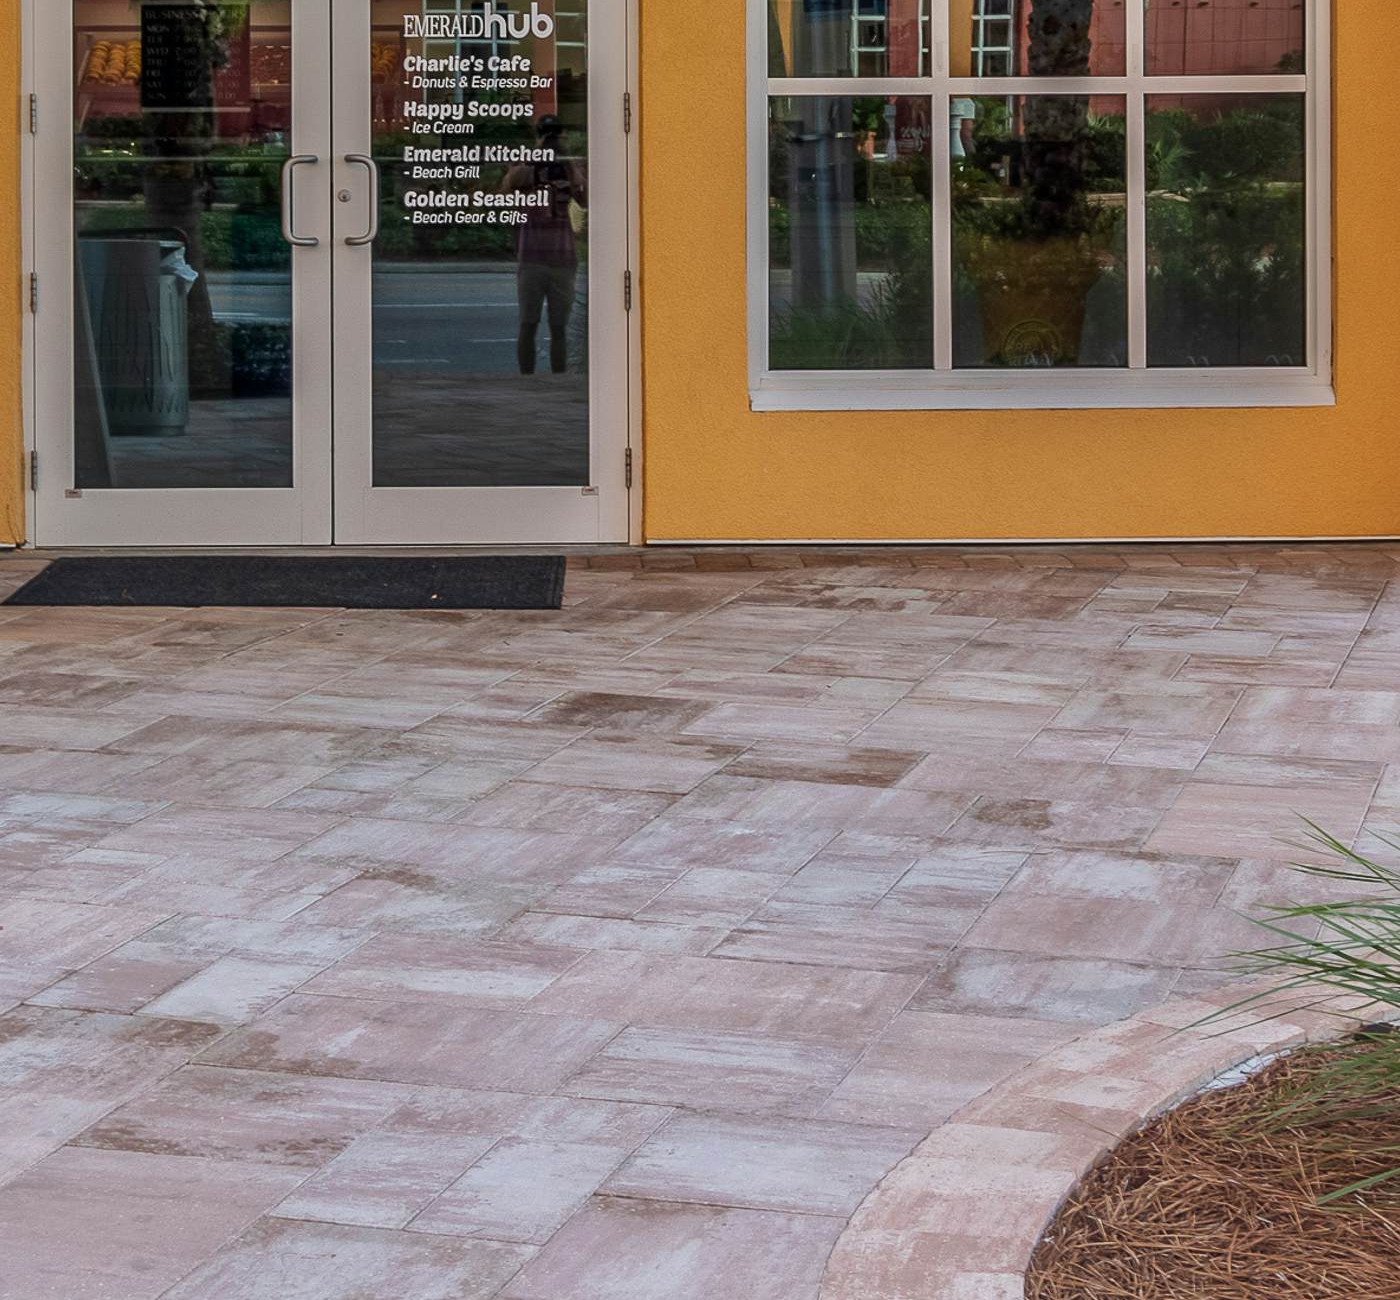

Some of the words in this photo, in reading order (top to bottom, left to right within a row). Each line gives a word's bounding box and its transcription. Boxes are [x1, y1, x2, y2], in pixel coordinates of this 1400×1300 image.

[403, 55, 484, 73] Charlie's
[487, 55, 531, 73] Cafe
[412, 76, 456, 89] Donuts
[459, 77, 468, 88] &
[471, 76, 527, 91] Espresso
[530, 76, 553, 89] Bar
[403, 101, 464, 120] Happy
[467, 101, 534, 120] Scoops
[412, 121, 430, 134] Ice
[433, 121, 474, 134] Cream
[403, 145, 480, 163] Emerald
[484, 145, 555, 163] Kitchen
[412, 166, 452, 179] Beach
[454, 166, 480, 179] Grill
[403, 190, 469, 208] Golden
[472, 190, 549, 208] Seashell
[412, 210, 452, 224] Beach
[454, 210, 484, 224] Gear
[487, 211, 496, 223] &
[499, 210, 528, 226] Gifts
